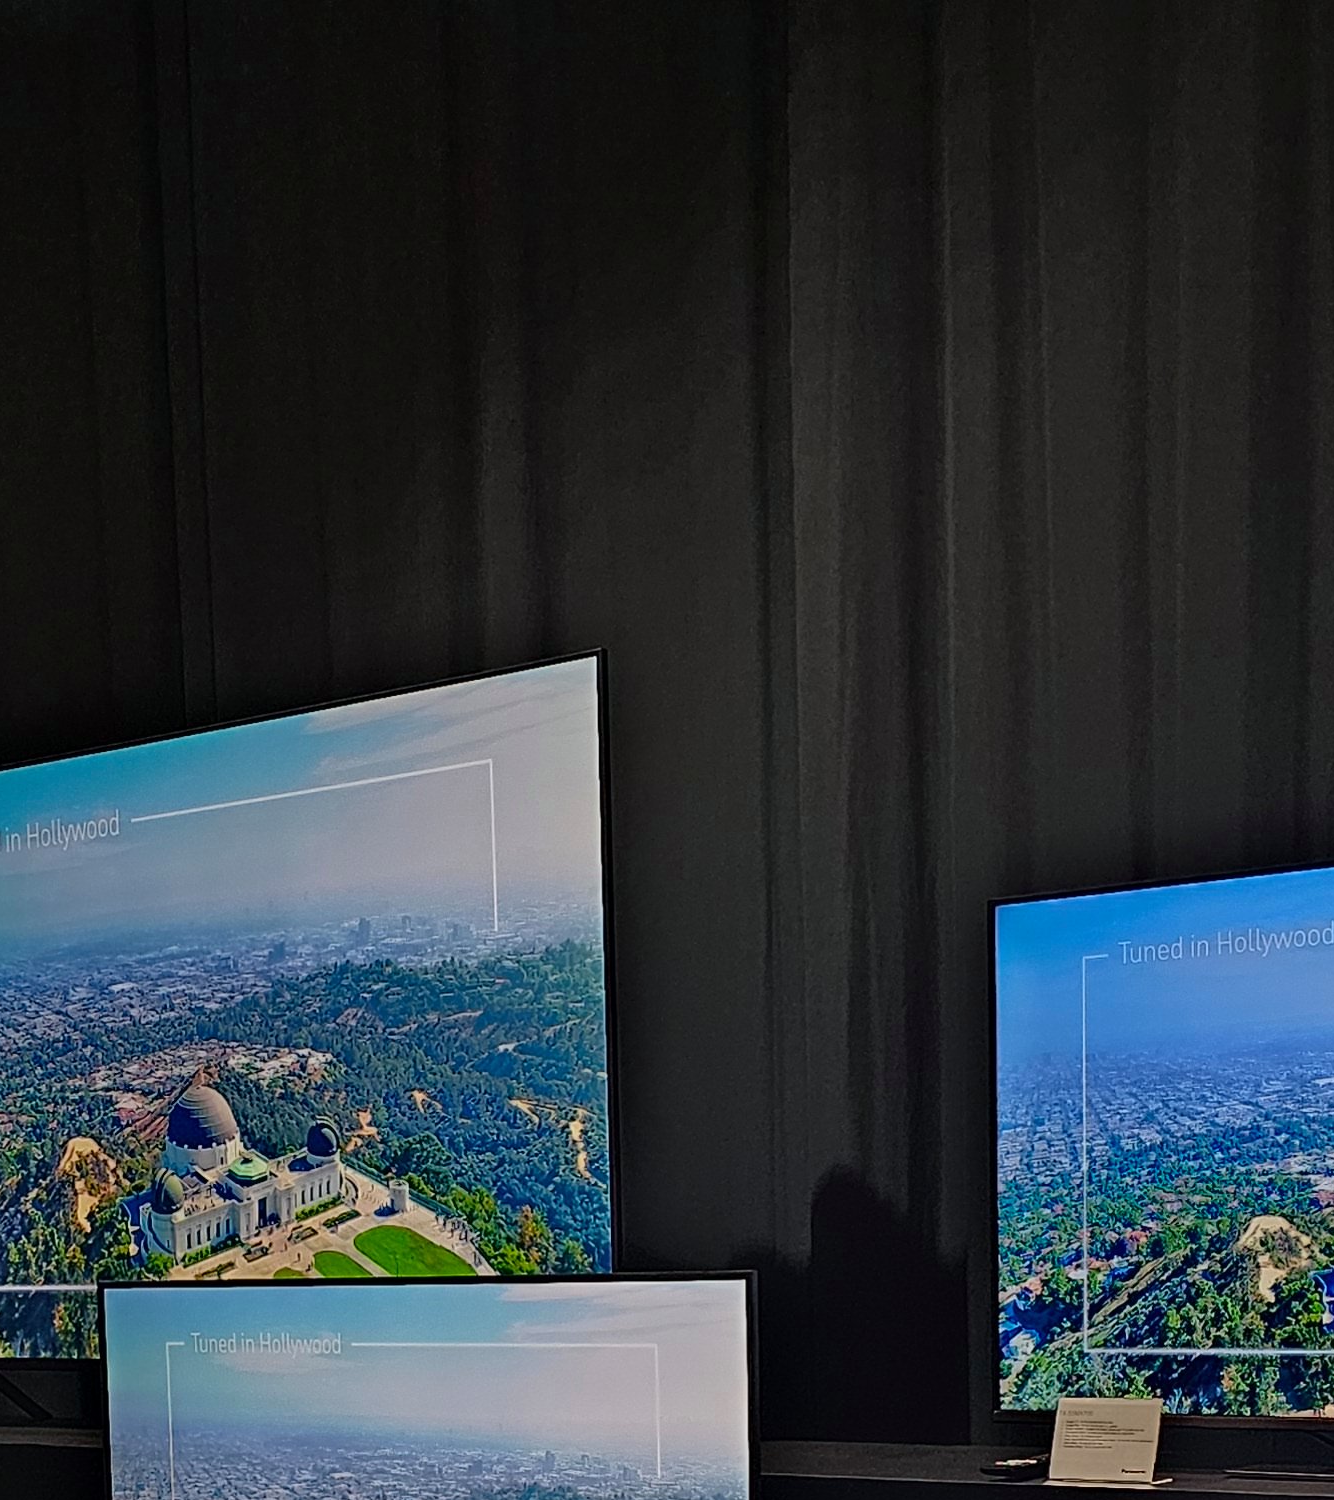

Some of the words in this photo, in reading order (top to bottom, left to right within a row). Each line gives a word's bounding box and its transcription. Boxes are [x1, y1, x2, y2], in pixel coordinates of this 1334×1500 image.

[5, 828, 21, 853] in
[26, 809, 120, 851] Hollywood
[1118, 936, 1183, 965] Tuned
[1190, 935, 1209, 958] in
[1218, 920, 1334, 957] Hollywood
[190, 1332, 236, 1353] Tuned
[241, 1333, 255, 1353] in
[260, 1332, 342, 1360] Hollywood
